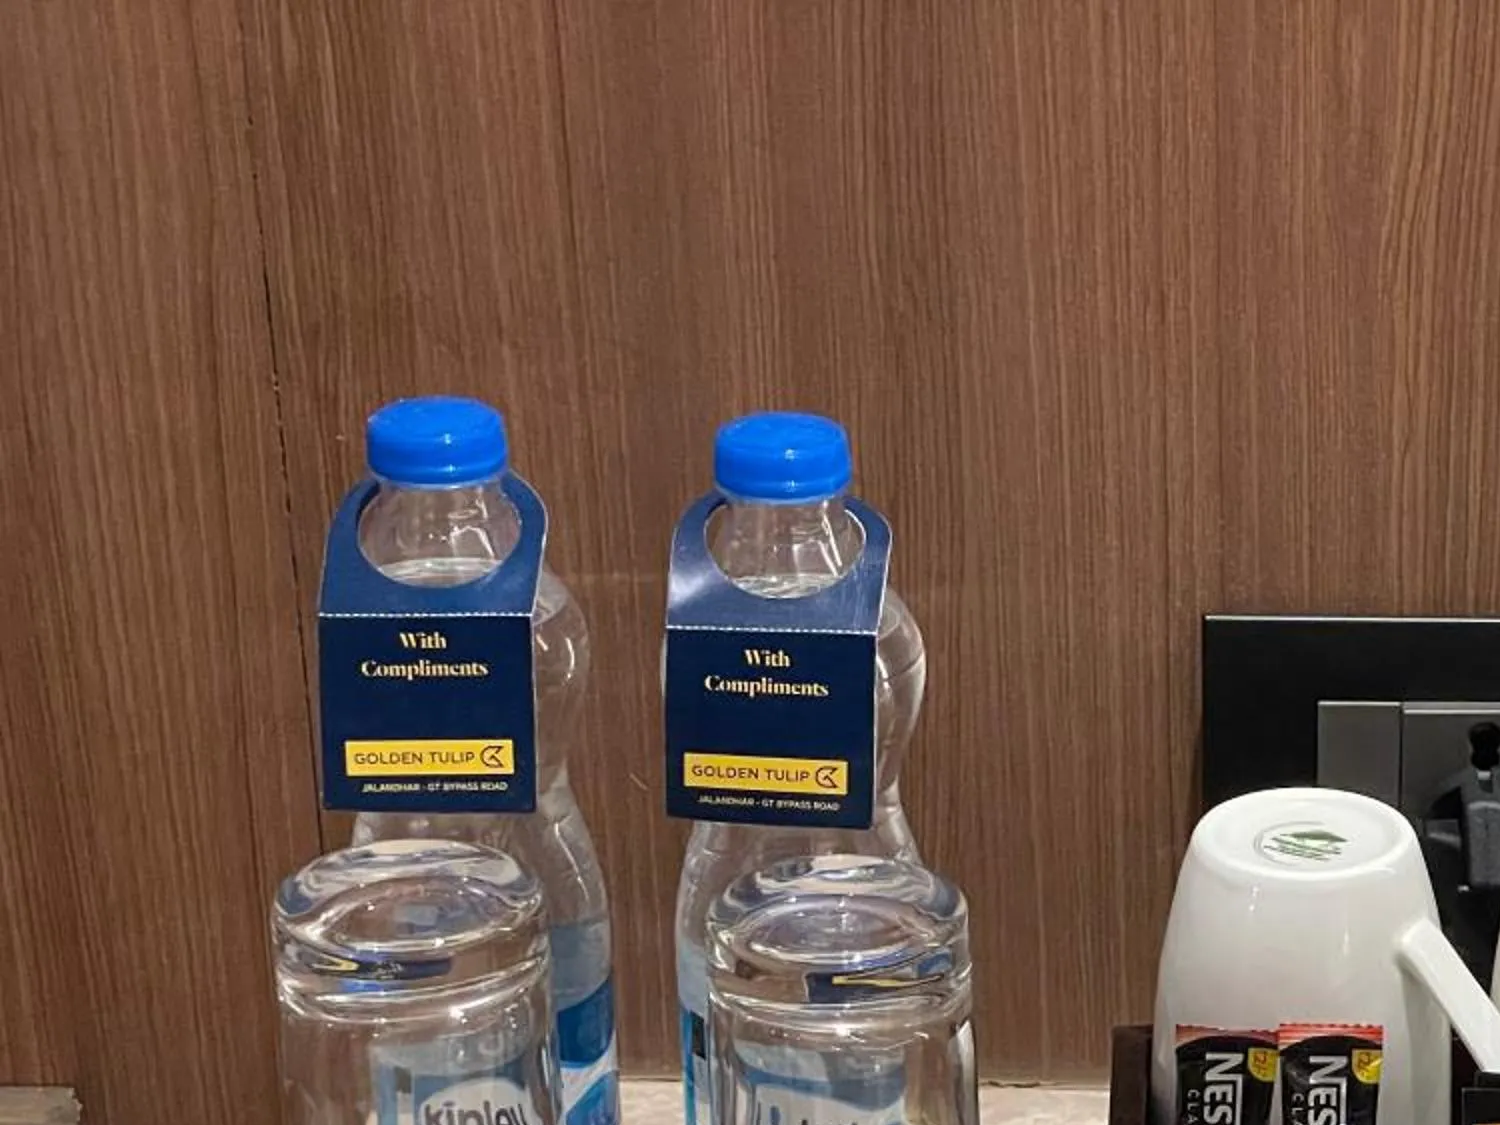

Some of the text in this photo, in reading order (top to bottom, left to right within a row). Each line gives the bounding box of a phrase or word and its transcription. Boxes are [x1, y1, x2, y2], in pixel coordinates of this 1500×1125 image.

[400, 632, 447, 649] With
[744, 649, 790, 667] With
[361, 660, 489, 680] Compliments
[704, 675, 829, 697] Compliments
[354, 751, 475, 765] GOLDEN TULIP
[691, 765, 811, 782] GOLDEN TULIP
[481, 782, 509, 791] ROAD
